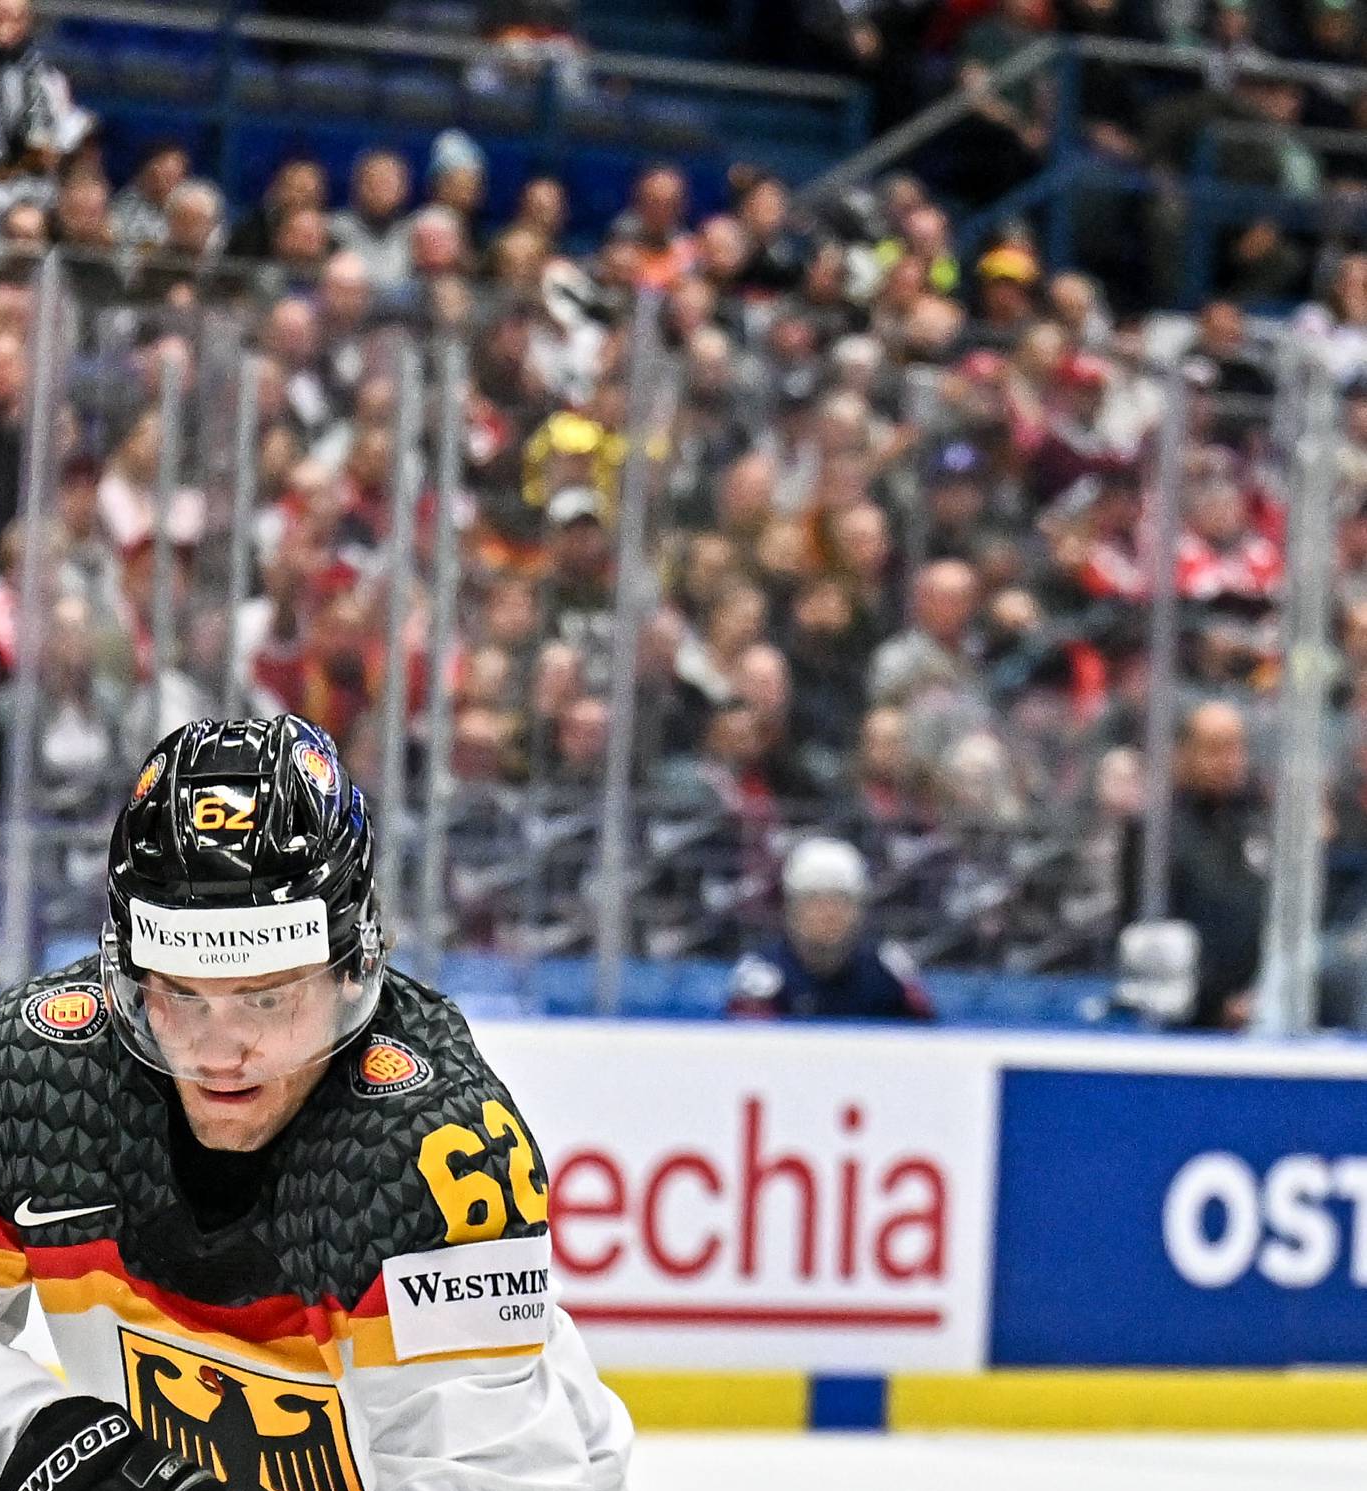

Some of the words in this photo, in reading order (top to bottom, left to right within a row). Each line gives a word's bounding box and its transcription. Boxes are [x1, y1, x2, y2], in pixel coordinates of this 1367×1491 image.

[193, 796, 257, 831] 62
[135, 913, 322, 949] WESTMINSTER
[198, 952, 251, 965] GROUP
[417, 1099, 550, 1245] 62
[549, 1094, 951, 1282] echia
[498, 1302, 546, 1322] GROUP
